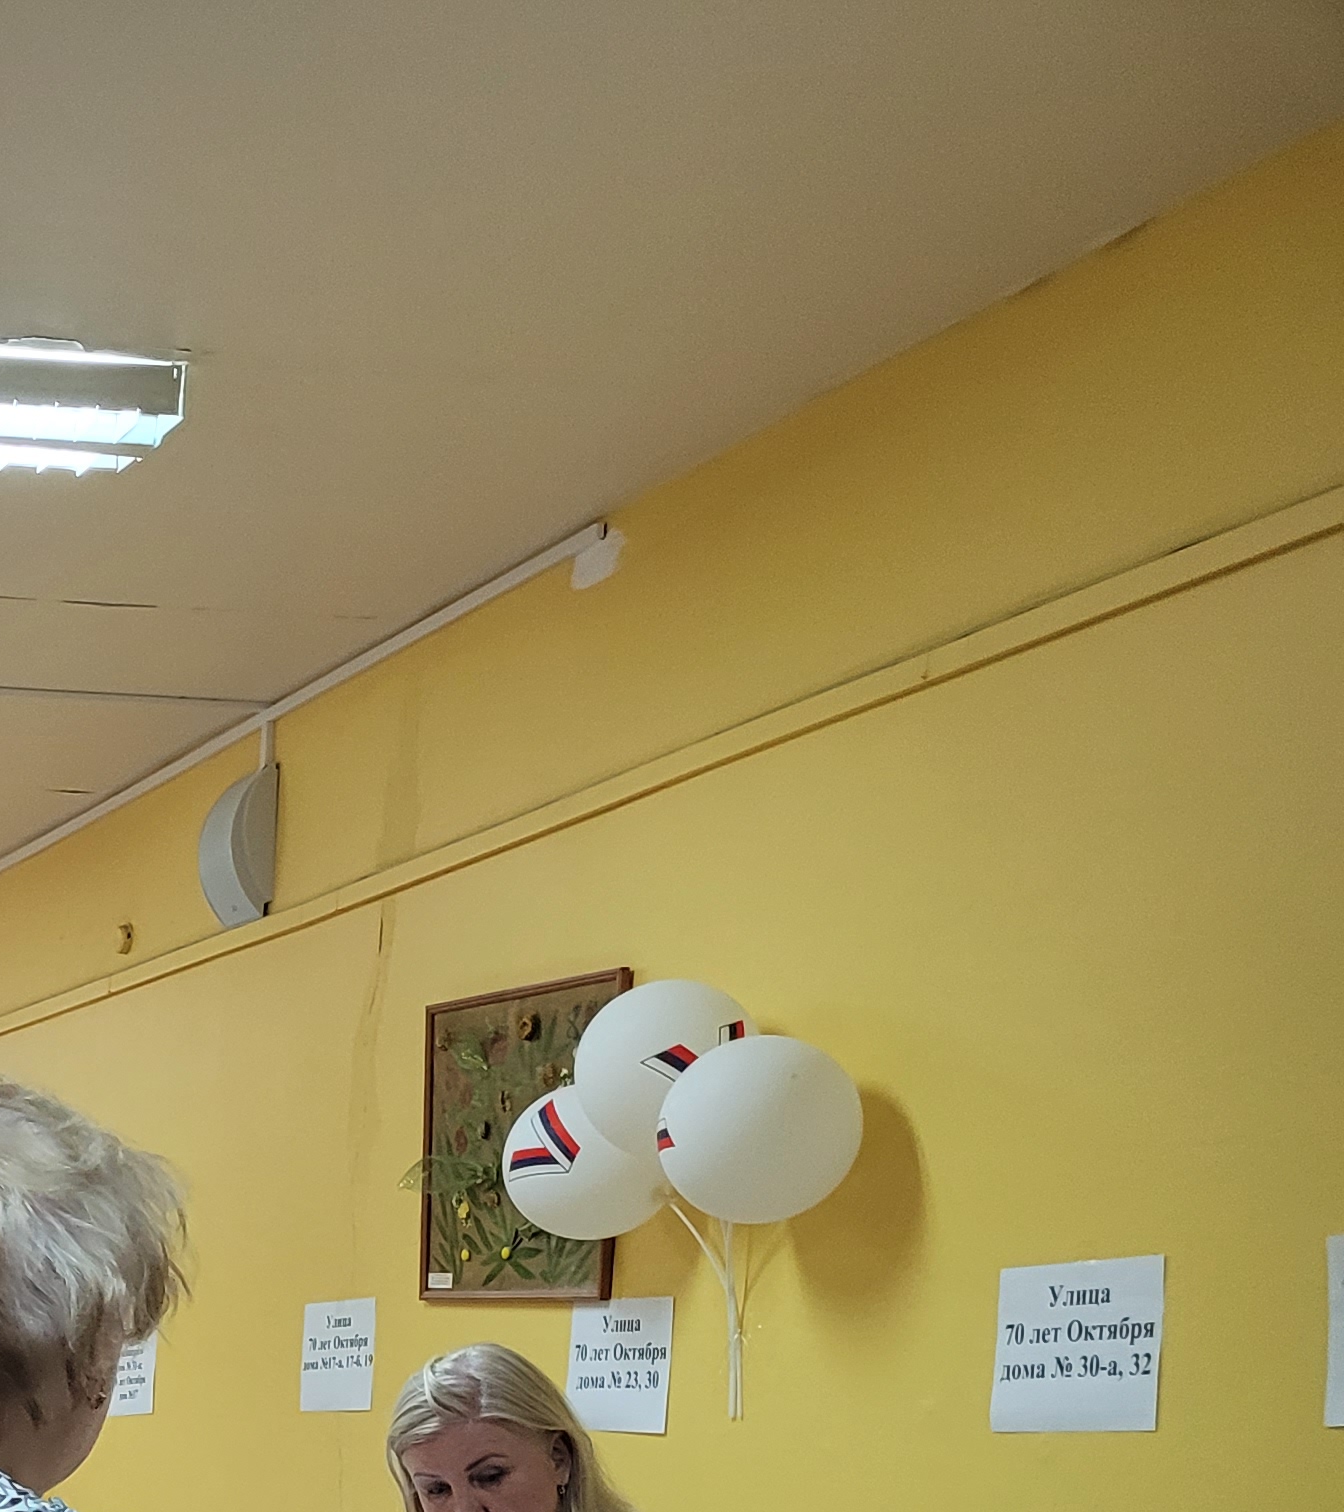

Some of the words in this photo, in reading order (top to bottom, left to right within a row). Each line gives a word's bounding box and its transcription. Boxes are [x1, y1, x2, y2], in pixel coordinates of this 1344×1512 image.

[1048, 1284, 1111, 1308] Улица
[326, 1315, 352, 1329] Улица
[602, 1315, 641, 1333] Улица
[1005, 1322, 1025, 1346] 70
[1028, 1326, 1062, 1345] лет
[1067, 1316, 1156, 1346] Октября
[308, 1337, 317, 1352] 70
[317, 1339, 331, 1351] лет
[333, 1333, 369, 1351] Октября
[575, 1343, 588, 1362] 70
[589, 1347, 611, 1361] лет
[613, 1341, 667, 1365] Октября
[364, 1353, 374, 1367] 19
[1000, 1363, 1046, 1382] дома
[1050, 1355, 1073, 1379] №
[1077, 1354, 1124, 1381] 30-а,
[1129, 1352, 1152, 1376] 32
[575, 1375, 605, 1390] дома
[607, 1370, 622, 1389] №
[625, 1370, 642, 1392] 23,
[645, 1370, 659, 1389] 30
